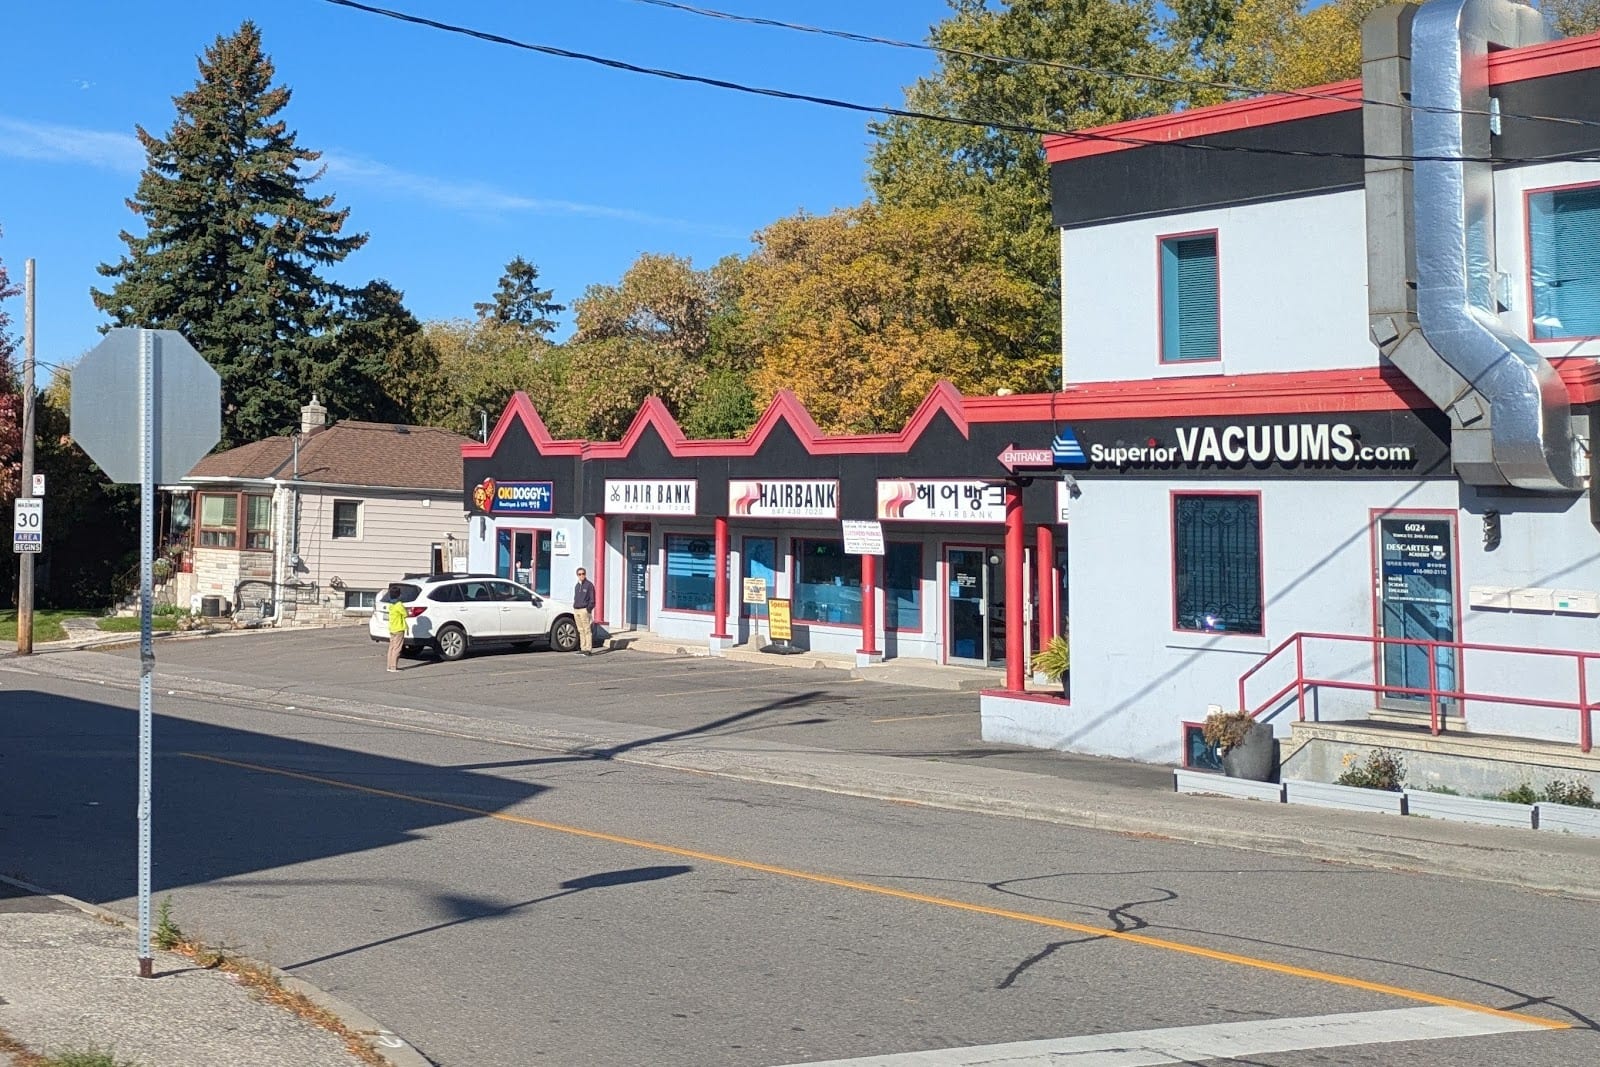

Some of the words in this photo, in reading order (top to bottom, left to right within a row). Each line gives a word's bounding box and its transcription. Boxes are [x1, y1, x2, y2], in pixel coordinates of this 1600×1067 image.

[1004, 450, 1051, 463] ENTRANCE
[624, 484, 652, 503] HAIR
[657, 484, 691, 504] BANK
[759, 483, 836, 509] HAIRBANK
[916, 484, 1007, 511] 헤어뱅크
[17, 513, 39, 527] 30
[930, 511, 993, 519] HAIRBANK
[1404, 523, 1426, 531] 6024
[15, 543, 40, 551] BEGINS
[1386, 543, 1430, 551] DESCARTES
